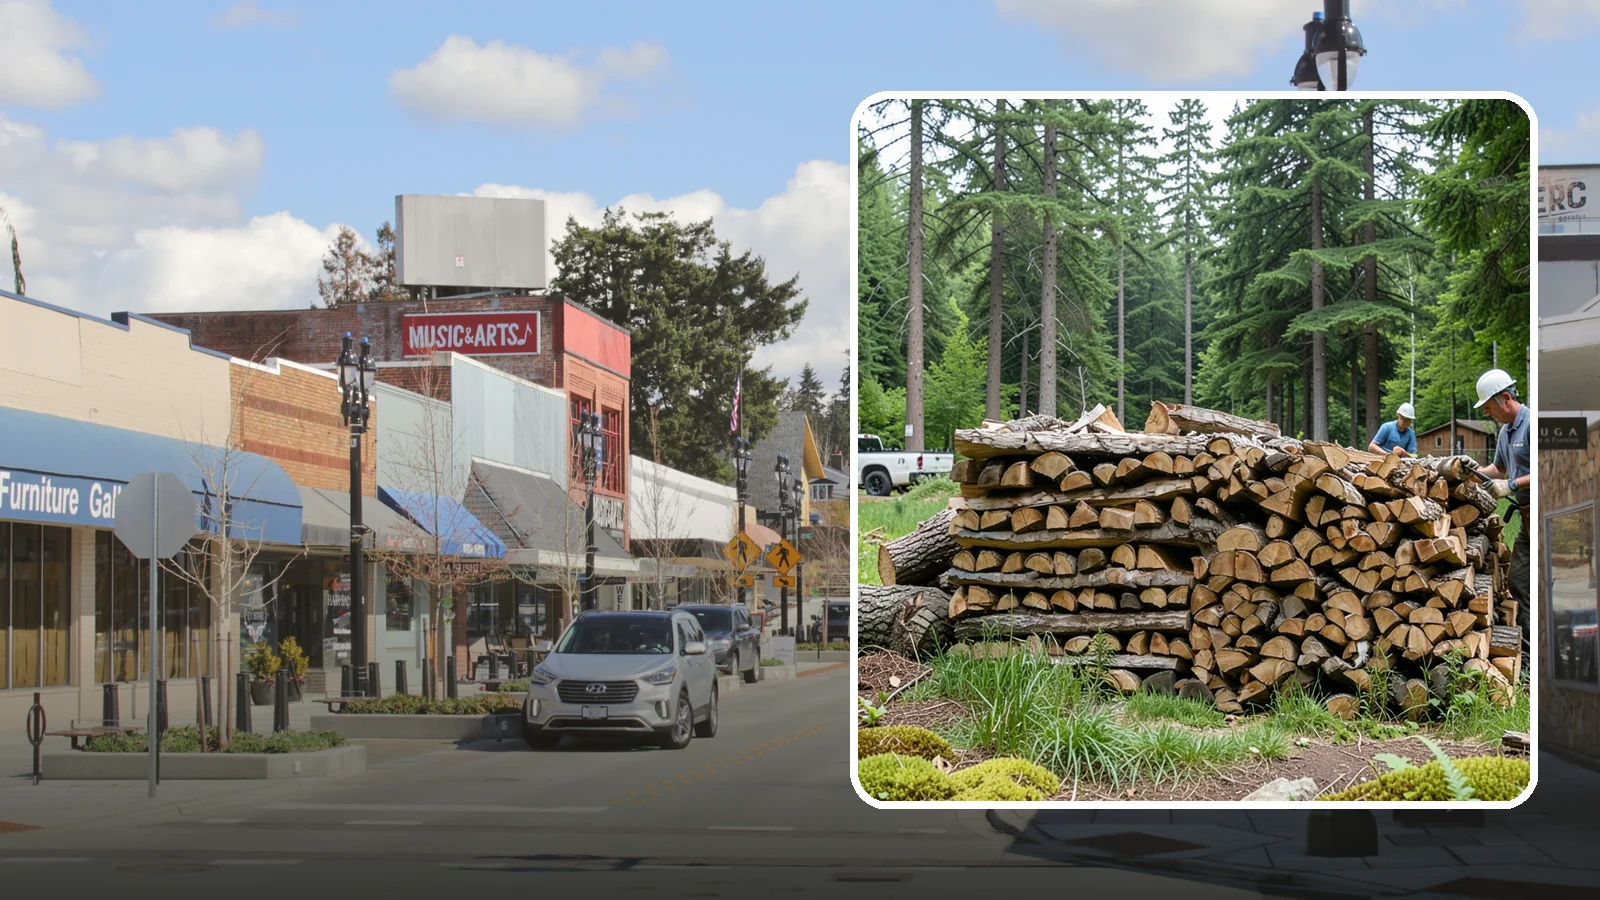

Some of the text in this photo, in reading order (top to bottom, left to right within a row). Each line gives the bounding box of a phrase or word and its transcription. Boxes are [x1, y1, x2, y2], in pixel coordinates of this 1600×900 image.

[0, 472, 122, 519] Furniture Gal
[453, 563, 479, 574] SUSHI
